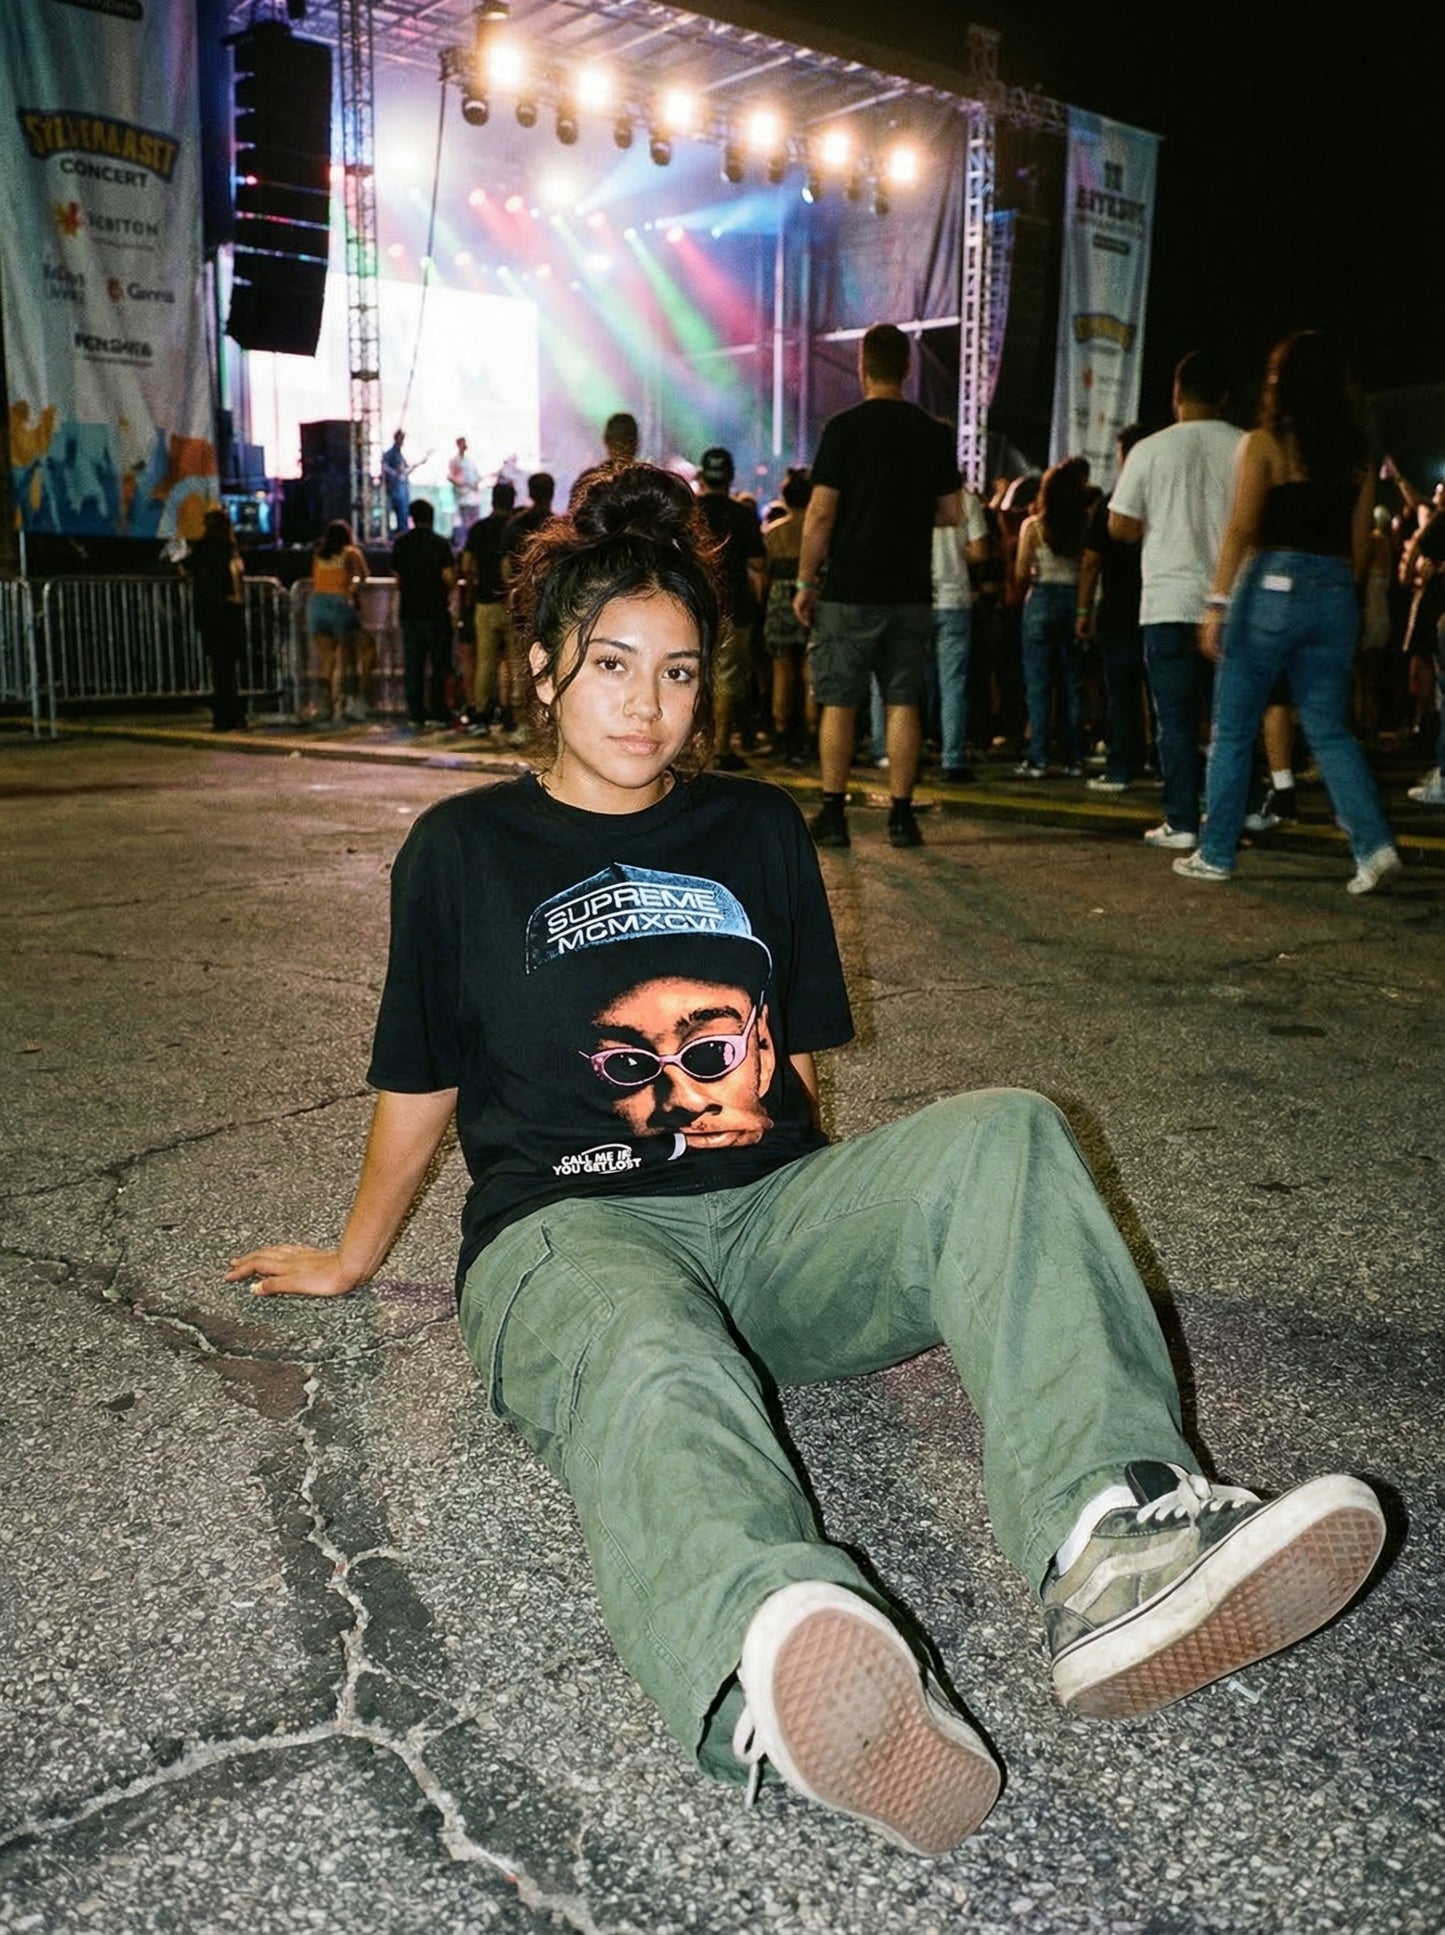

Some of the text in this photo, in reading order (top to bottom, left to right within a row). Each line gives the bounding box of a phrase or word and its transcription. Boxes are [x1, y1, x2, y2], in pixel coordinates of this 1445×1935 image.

[60, 158, 148, 188] CONCERT
[547, 886, 720, 935] SUPREME
[561, 1154, 592, 1166] CALL
[595, 1151, 614, 1162] ME
[552, 1164, 581, 1176] YOU
